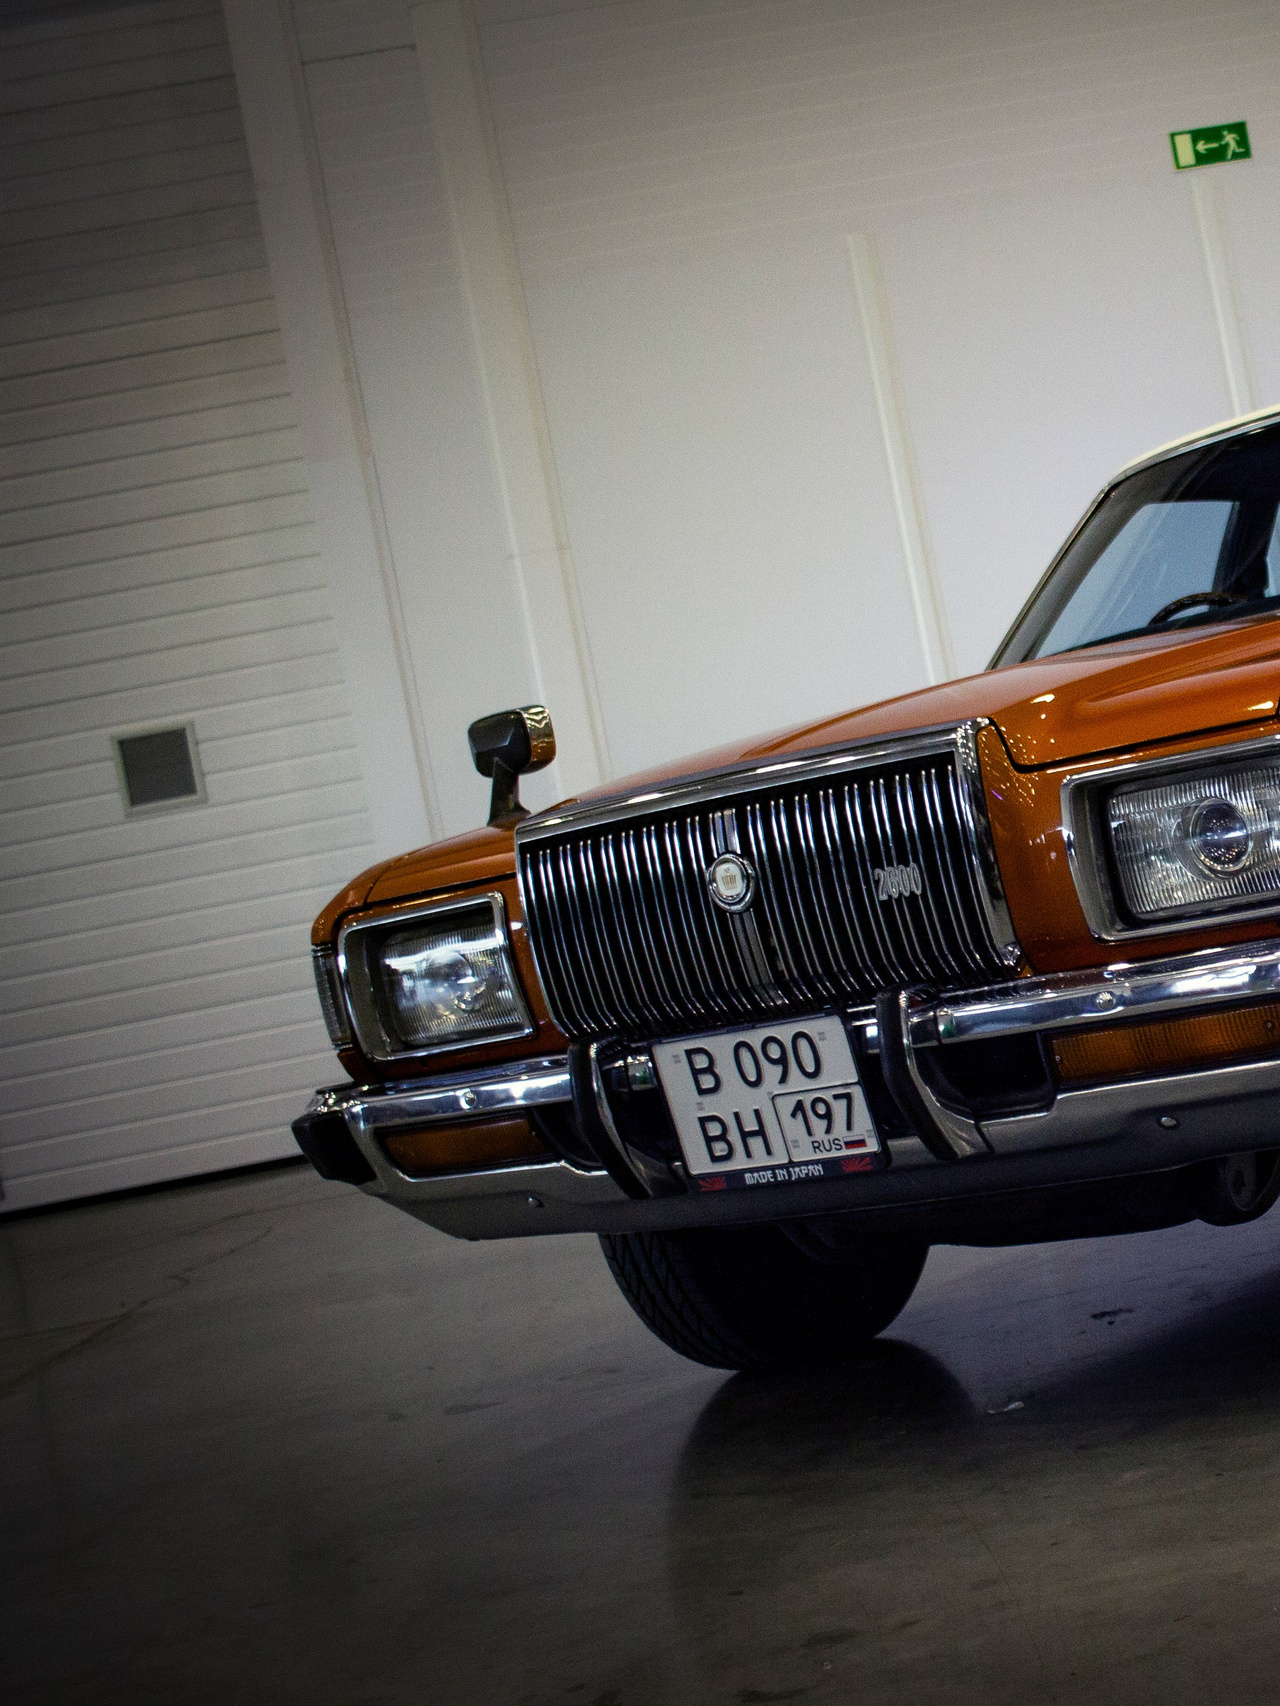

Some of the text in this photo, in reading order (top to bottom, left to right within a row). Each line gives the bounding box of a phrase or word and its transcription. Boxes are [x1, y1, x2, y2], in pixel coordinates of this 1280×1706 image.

[684, 1031, 822, 1096] B 090
[697, 1108, 774, 1163] BH
[790, 1091, 854, 1137] 197
[811, 1138, 843, 1154] RUS
[744, 1163, 824, 1185] MADE IN JAPAN
